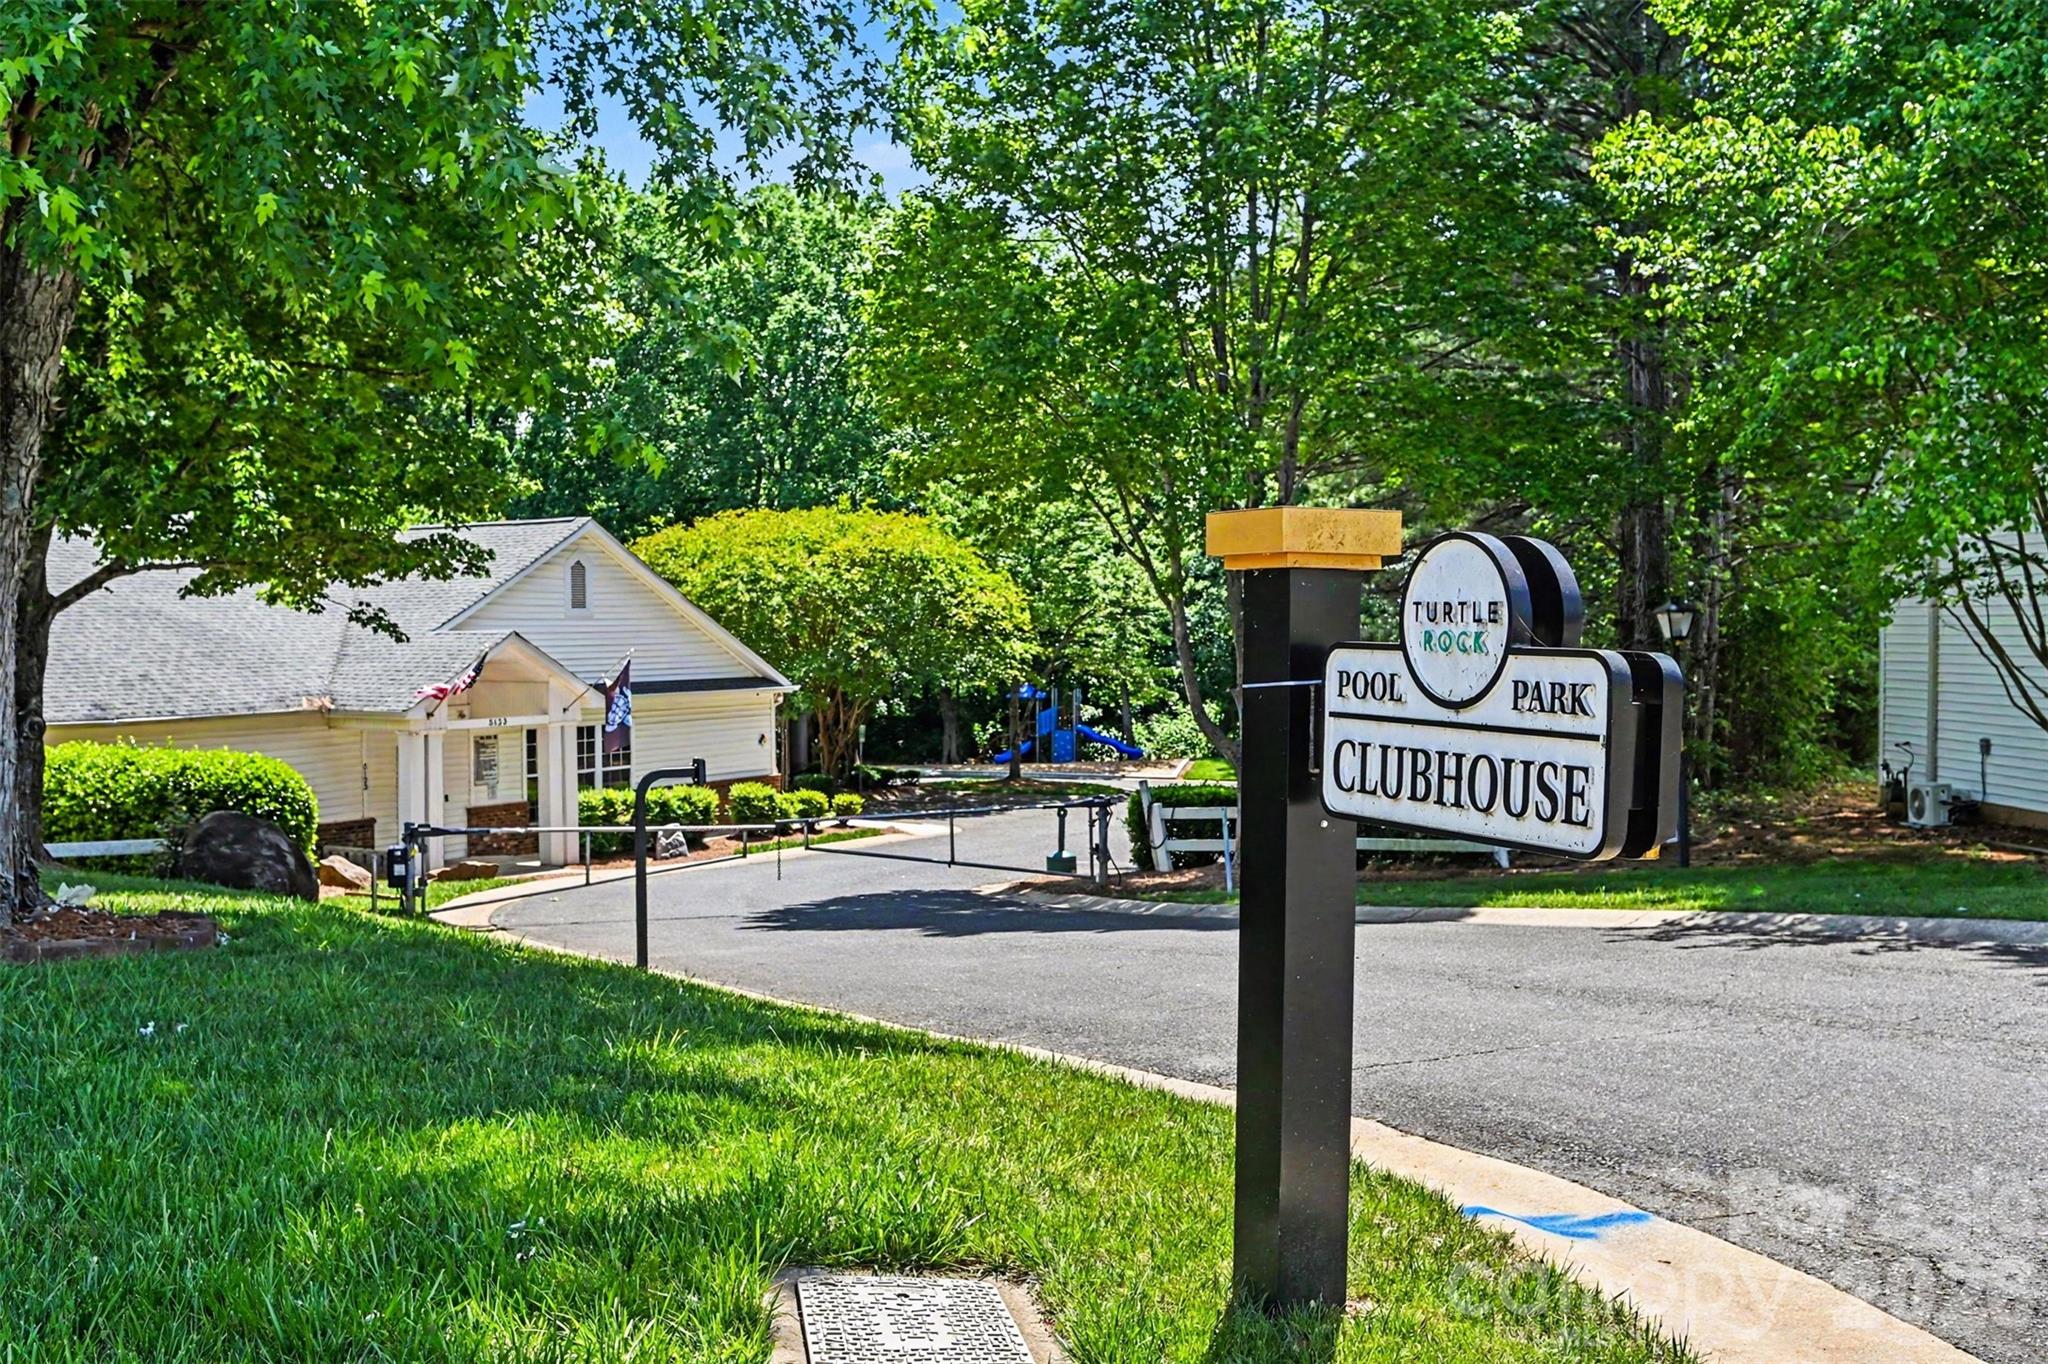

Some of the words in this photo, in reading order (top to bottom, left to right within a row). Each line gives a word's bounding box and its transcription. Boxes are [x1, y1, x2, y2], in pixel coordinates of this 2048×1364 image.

[1412, 601, 1500, 624] TURTLE
[1423, 630, 1489, 655] ROCK
[1337, 670, 1404, 703] POOL
[1511, 679, 1596, 718] PARK
[1332, 739, 1594, 829] CLUBHOUSE
